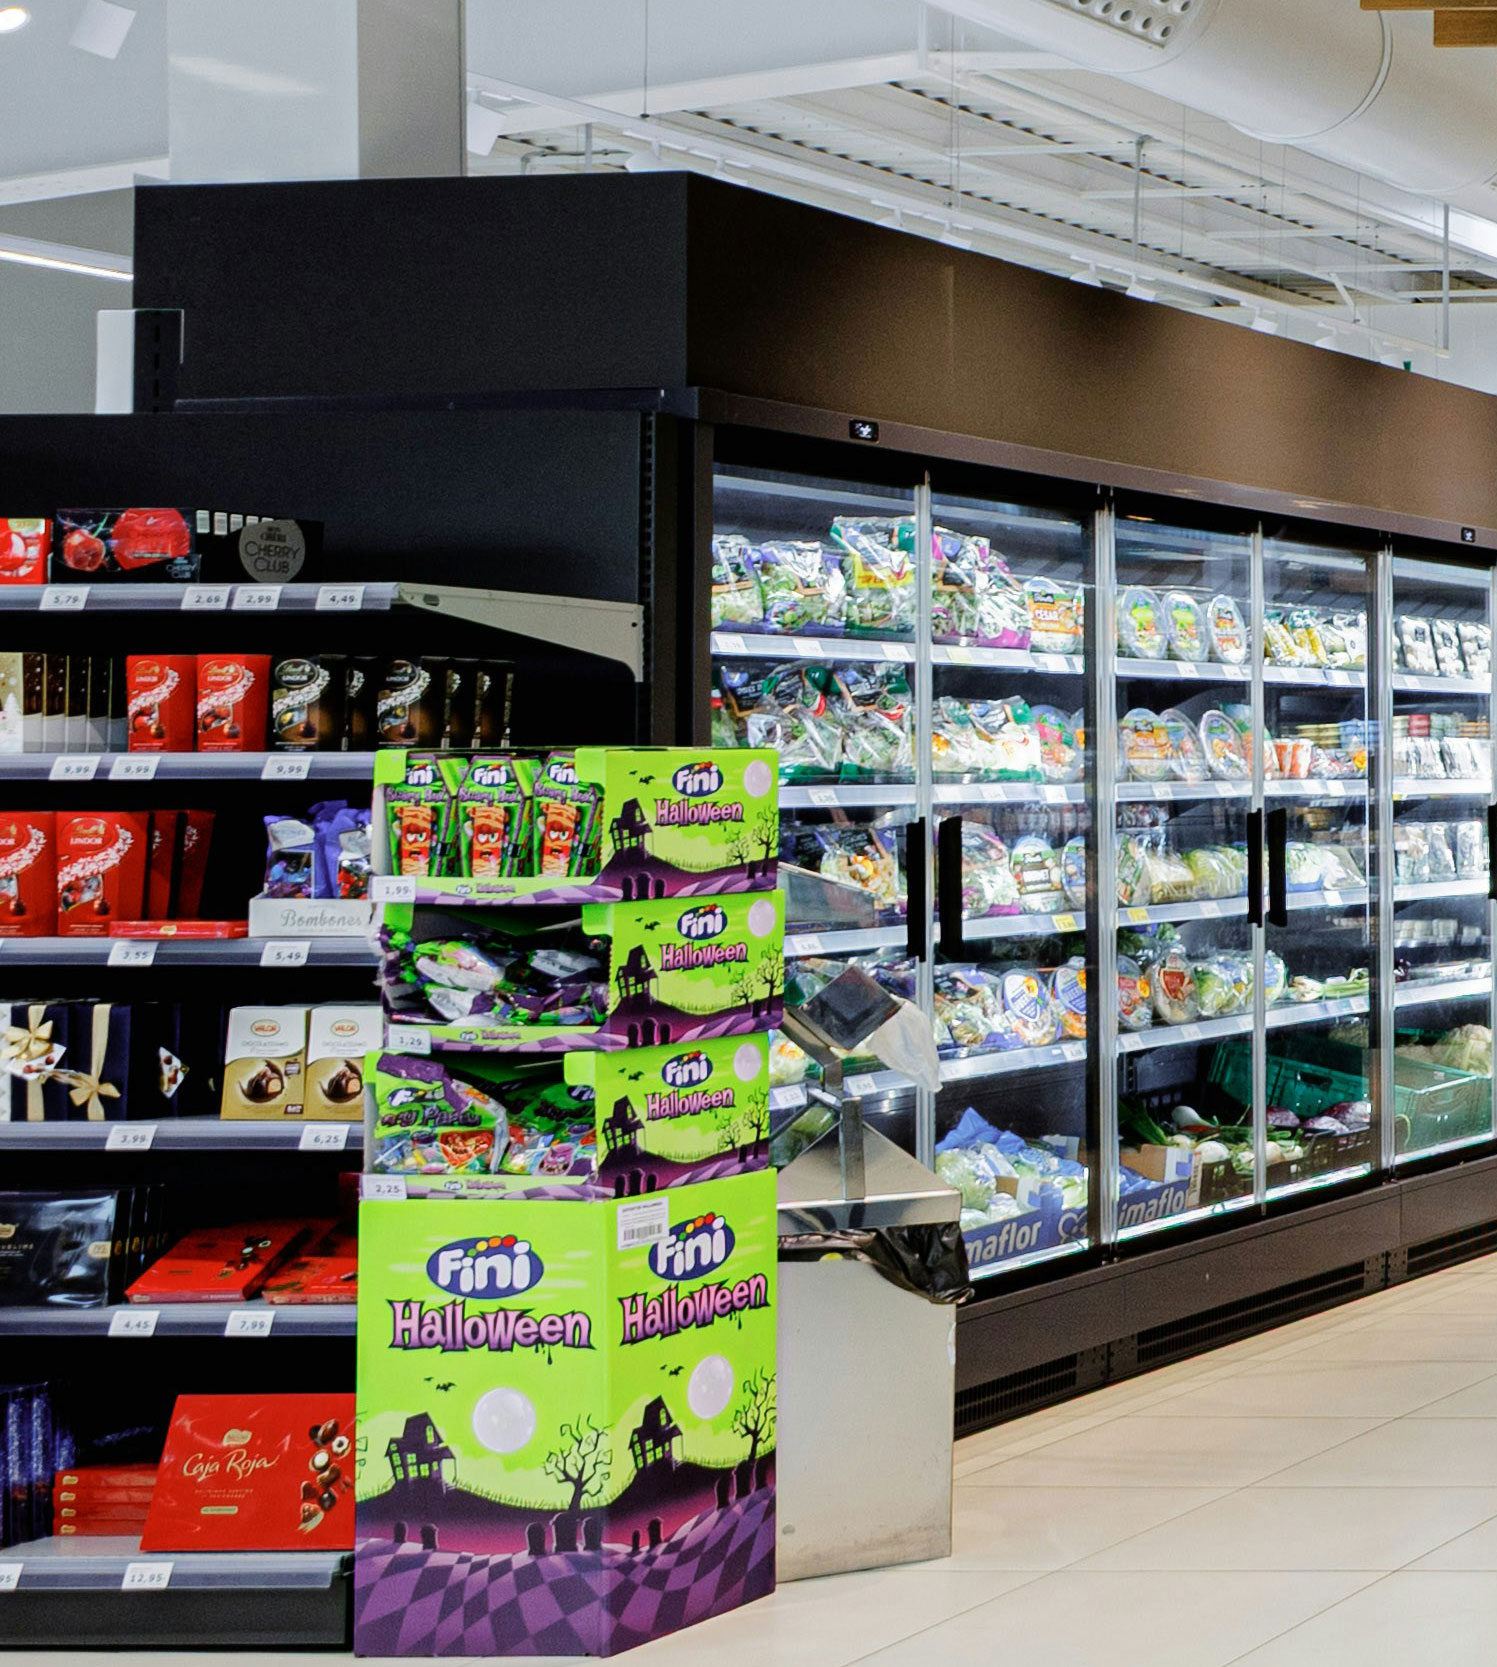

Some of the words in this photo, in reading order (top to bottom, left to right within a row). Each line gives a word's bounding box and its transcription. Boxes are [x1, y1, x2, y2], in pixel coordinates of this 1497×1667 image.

[245, 541, 300, 559] CHERRY
[253, 557, 290, 574] CLUB
[404, 767, 433, 786] ini
[473, 767, 507, 786] Fini
[550, 764, 578, 784] Fin
[677, 766, 719, 794] Fini
[655, 798, 744, 827] Halloween
[385, 886, 409, 895] 1,99
[280, 909, 363, 928] Bombones
[681, 907, 723, 937] Fini
[660, 942, 748, 971] Halloween
[665, 1055, 708, 1084] Fini
[645, 1086, 734, 1120] Halloween
[314, 1134, 341, 1144] 6,25
[376, 1184, 400, 1194] 2,25
[657, 1215, 726, 1275] Fini
[438, 1240, 531, 1294] Fini
[618, 1274, 771, 1347] Halloween
[387, 1298, 597, 1353] Halloween
[182, 1452, 221, 1483] Caja
[226, 1449, 281, 1482] Roja
